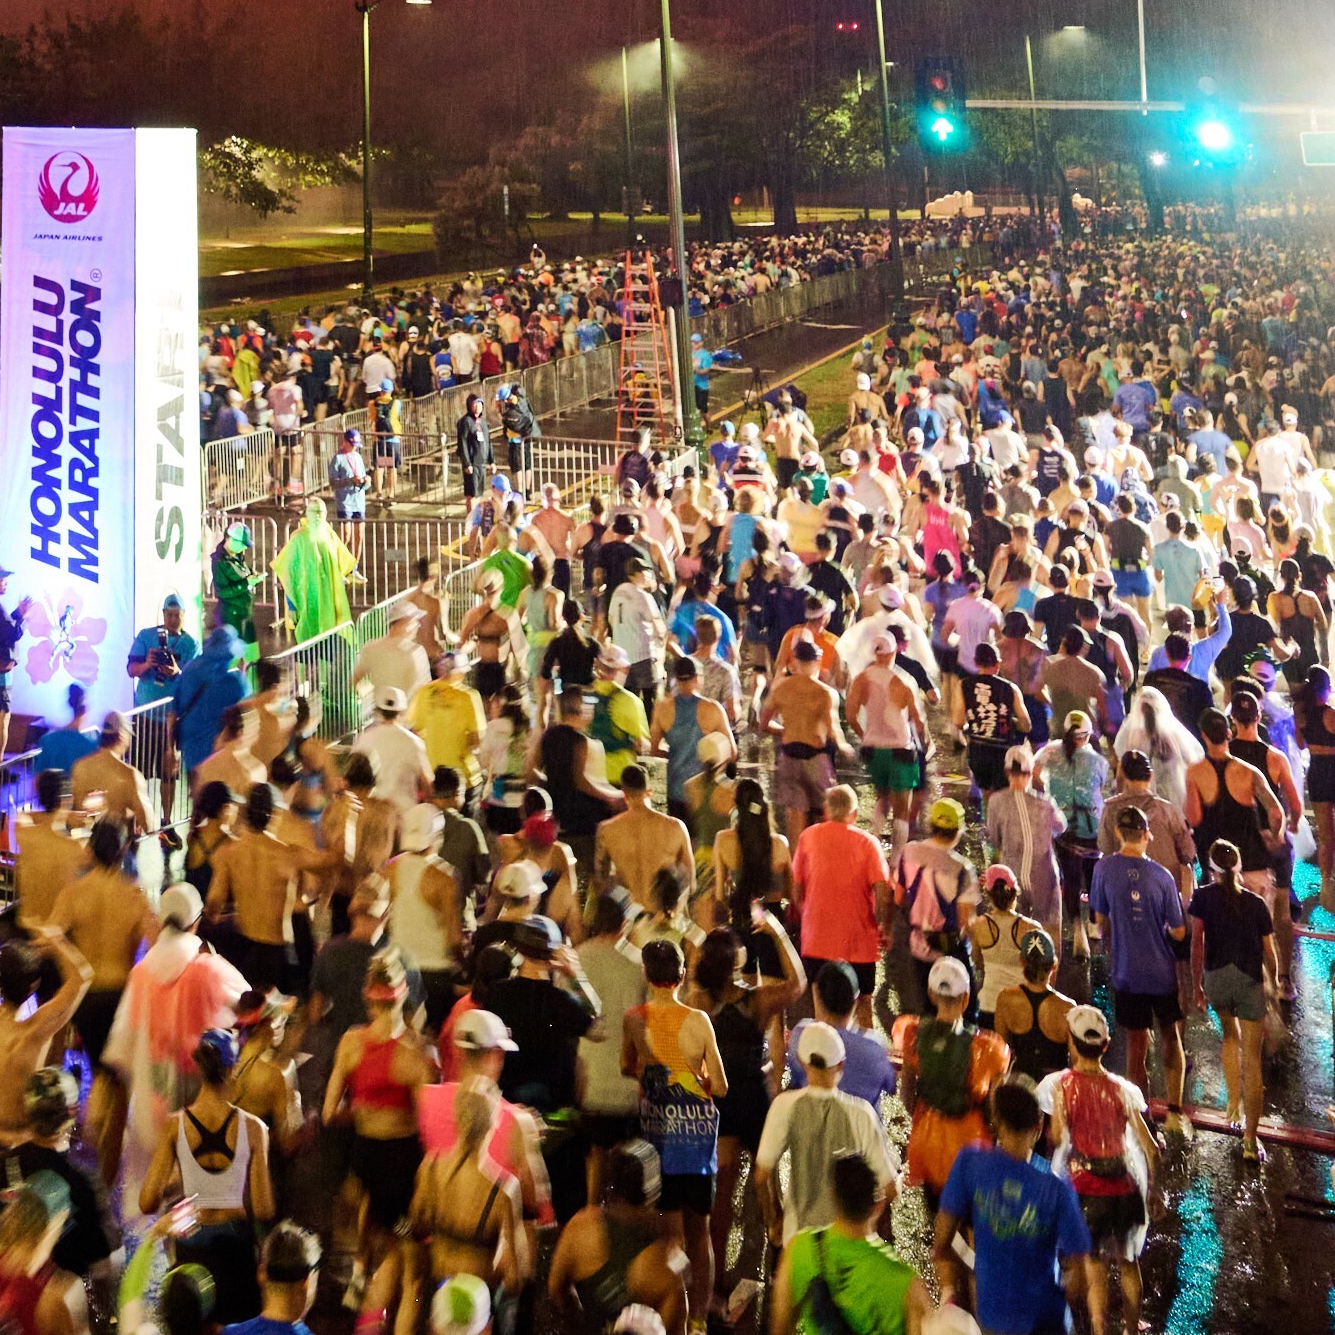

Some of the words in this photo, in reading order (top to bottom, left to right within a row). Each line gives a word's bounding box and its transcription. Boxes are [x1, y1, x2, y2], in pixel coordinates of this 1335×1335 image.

[32, 233, 61, 241] JAPAN
[62, 234, 103, 242] AIRLINES
[53, 202, 88, 216] JAL
[29, 274, 66, 569] HONOLULU
[67, 278, 102, 585] MARATHON
